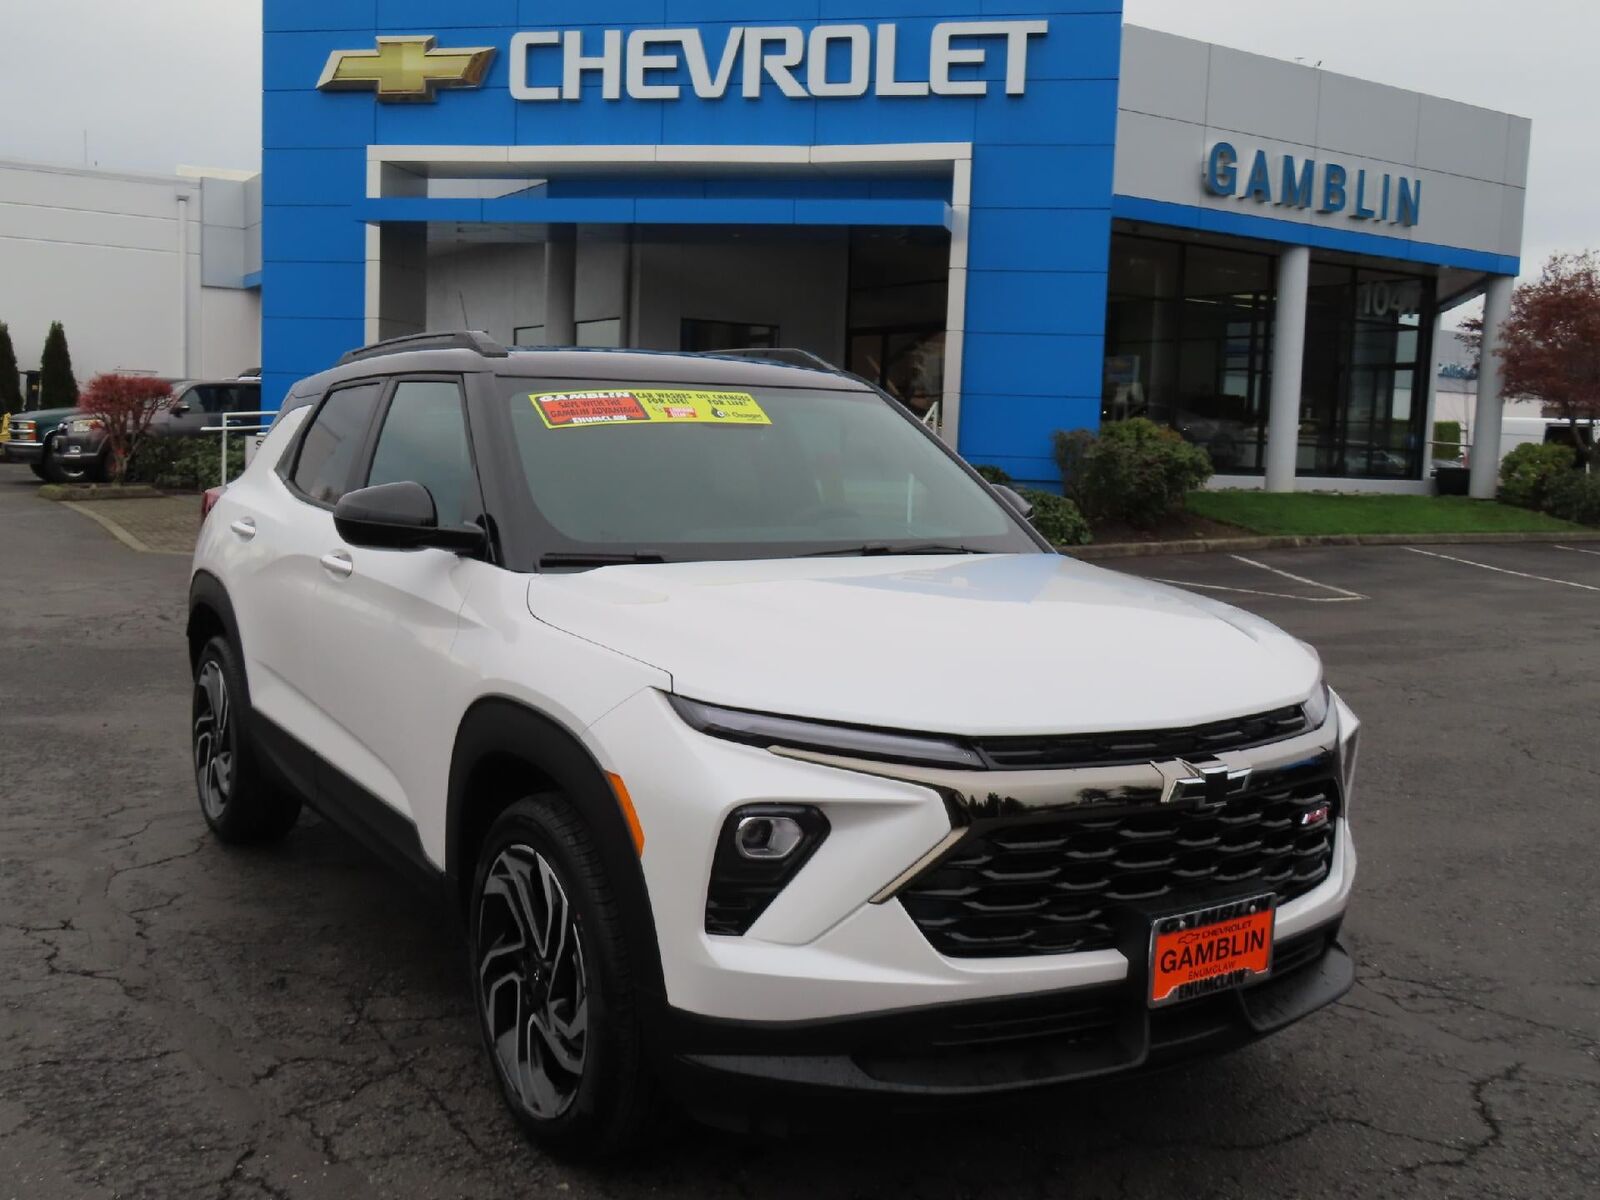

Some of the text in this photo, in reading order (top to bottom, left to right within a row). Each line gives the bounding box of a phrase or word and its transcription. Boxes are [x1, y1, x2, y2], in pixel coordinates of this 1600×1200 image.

[509, 20, 1048, 100] CHEVROLET
[1205, 142, 1422, 228] GAMBLIN
[539, 391, 630, 402] GAMBLIN
[1202, 919, 1253, 939] CHEVROLET
[1160, 928, 1265, 974] GAMBLIN
[1178, 967, 1246, 999] ENUMCLAW
[1188, 960, 1237, 981] ENUMCLAW
